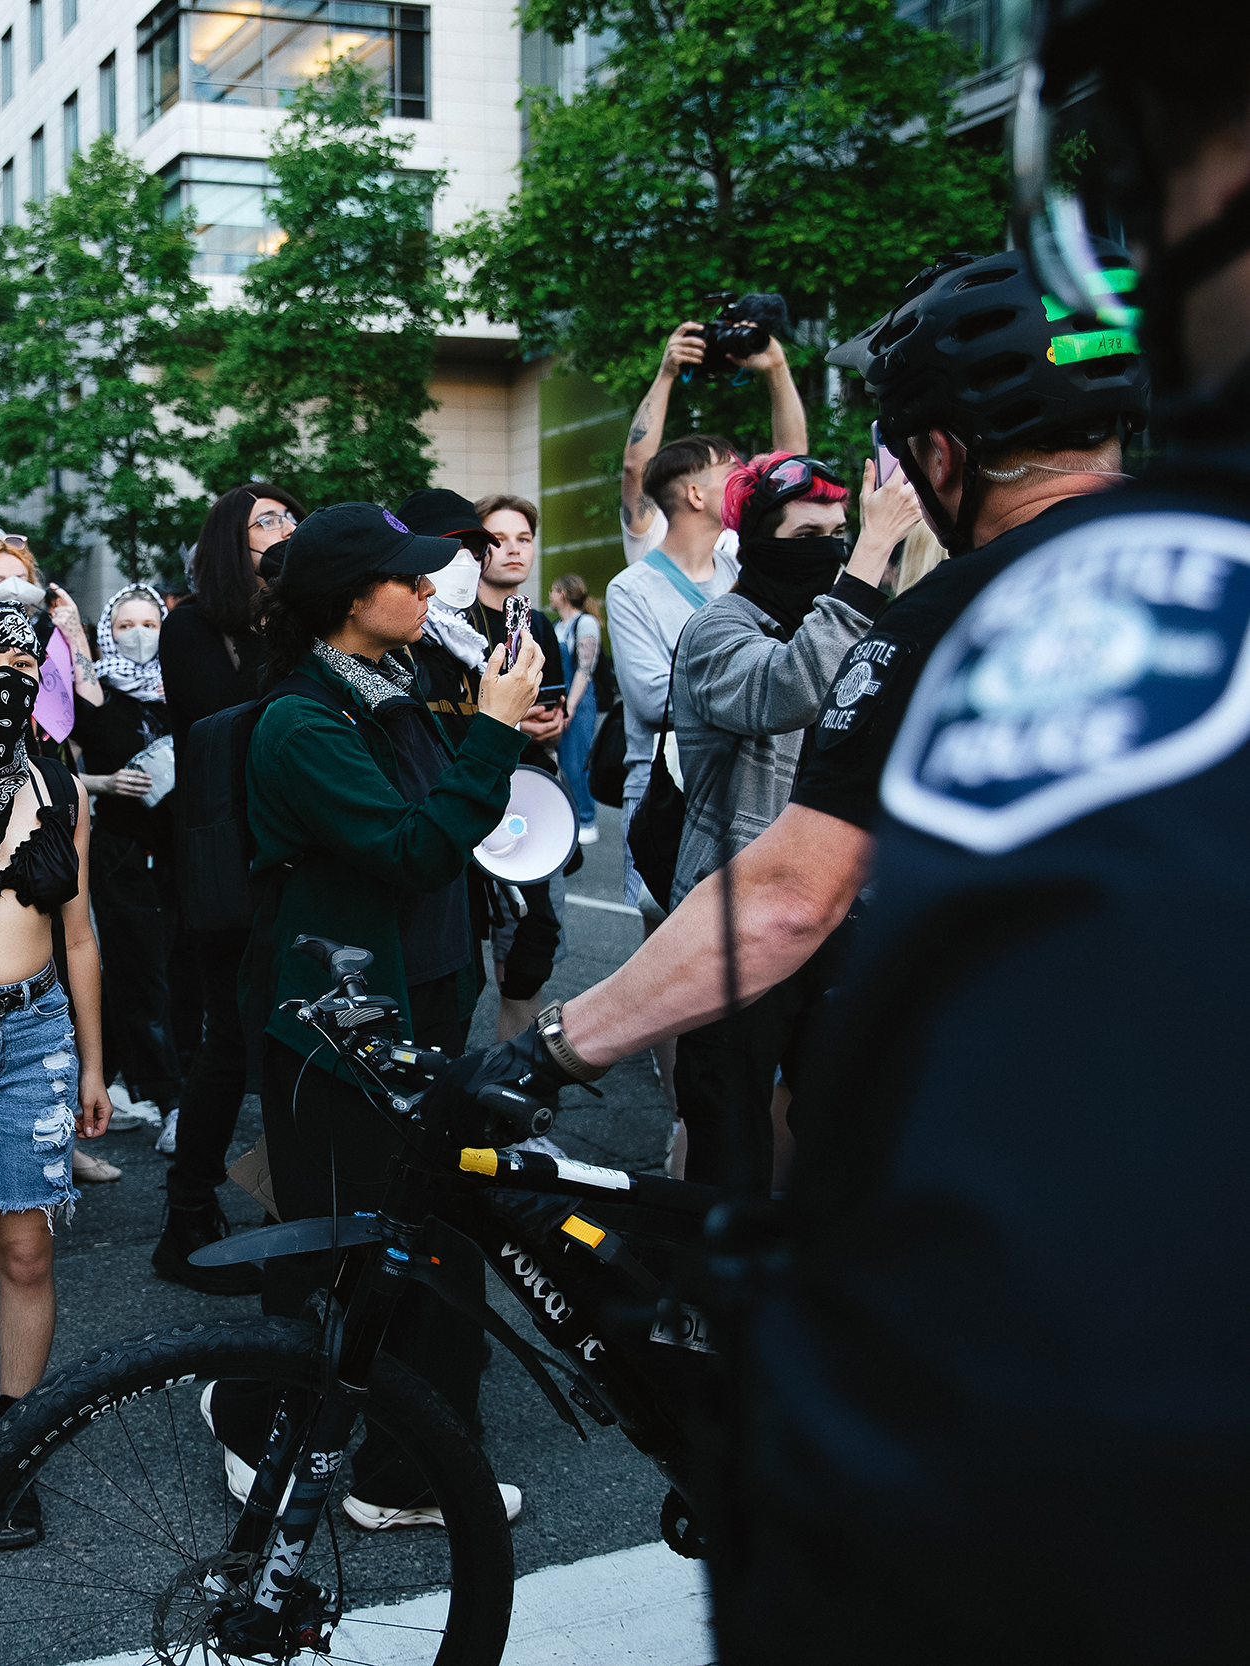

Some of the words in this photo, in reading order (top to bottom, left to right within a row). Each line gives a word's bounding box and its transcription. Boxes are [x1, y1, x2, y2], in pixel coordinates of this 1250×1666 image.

[849, 641, 897, 667] SEATTLE
[819, 709, 856, 730] POLICE
[158, 1373, 197, 1392] DT
[89, 1385, 153, 1424] SWISS
[17, 1393, 110, 1470] SERFAS
[310, 1449, 344, 1474] 32
[253, 1528, 306, 1614] FOX
